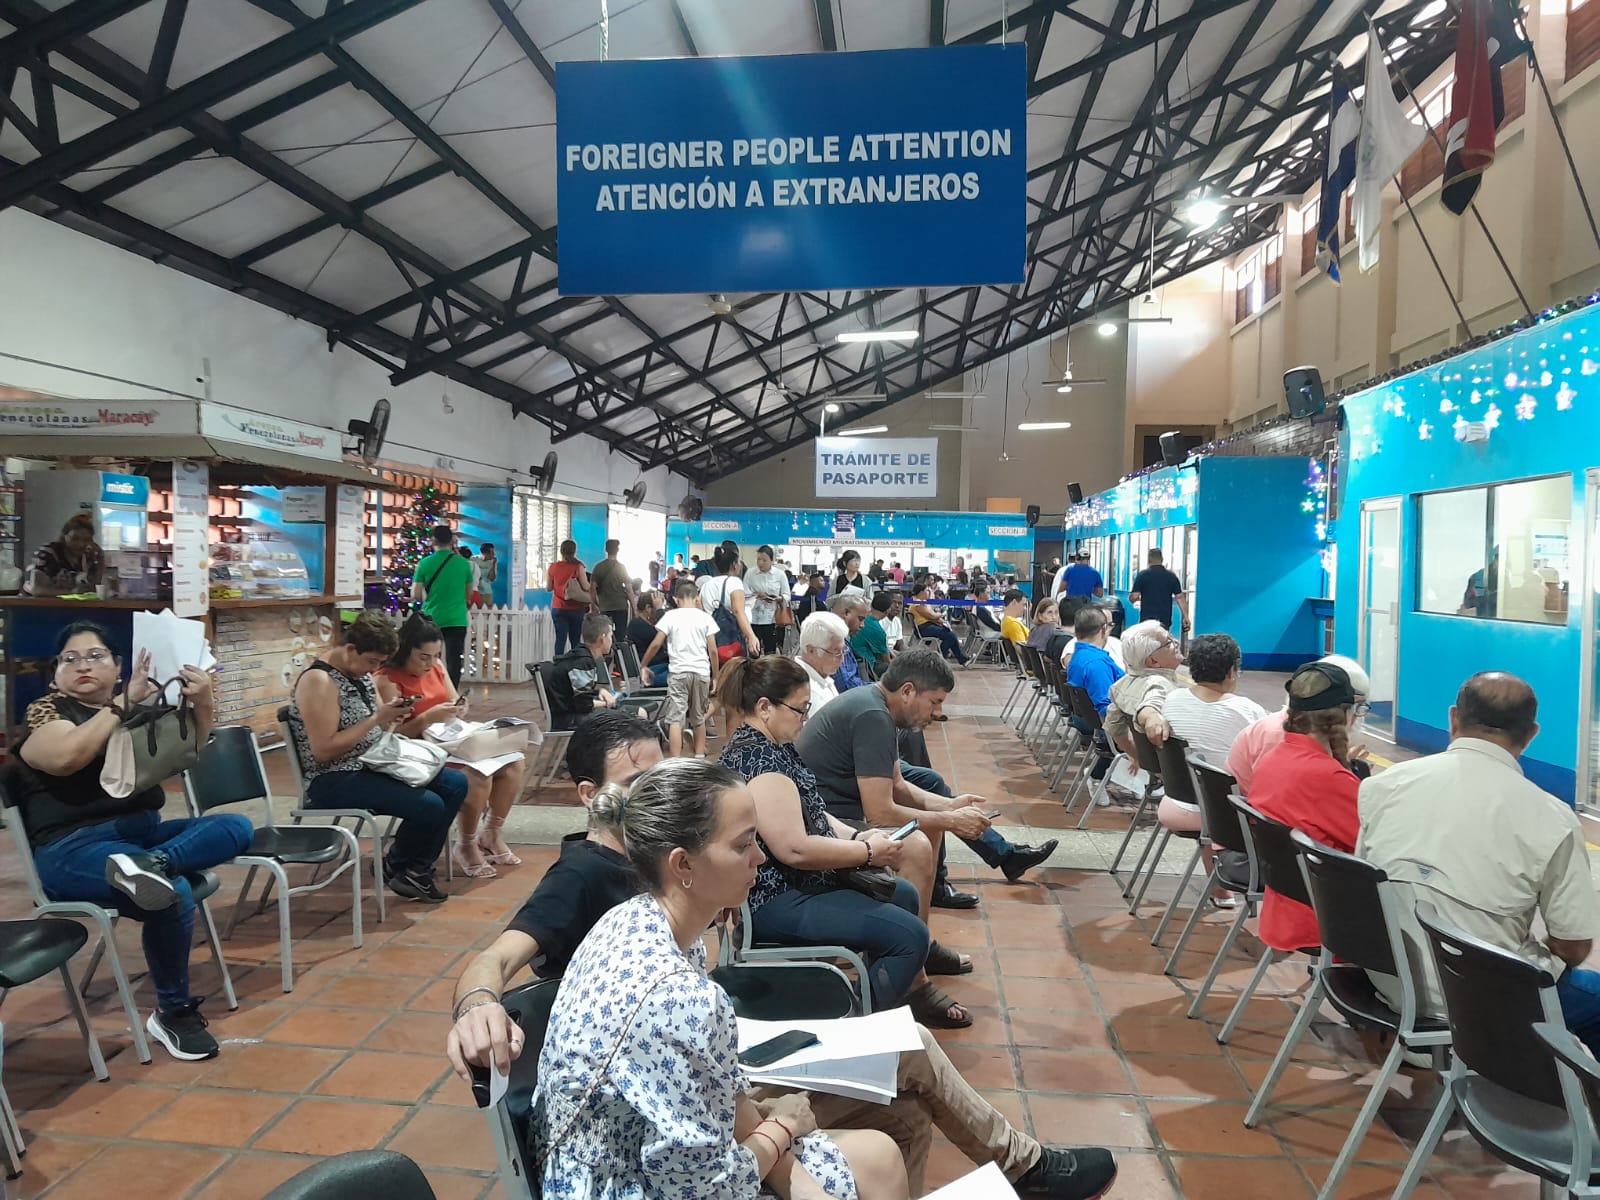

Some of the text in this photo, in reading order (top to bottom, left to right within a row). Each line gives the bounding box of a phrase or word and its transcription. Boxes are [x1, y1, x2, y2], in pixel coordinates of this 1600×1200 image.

[566, 128, 1012, 171] FOREIGNER PEOPLE ATTENTION
[595, 172, 981, 212] ATENCIÓN A EXTRANJEROS
[0, 414, 88, 423] enezolanas
[97, 408, 156, 427] Maracay
[821, 451, 932, 466] TRÁMITE DE
[822, 472, 929, 485] PASAPORTE
